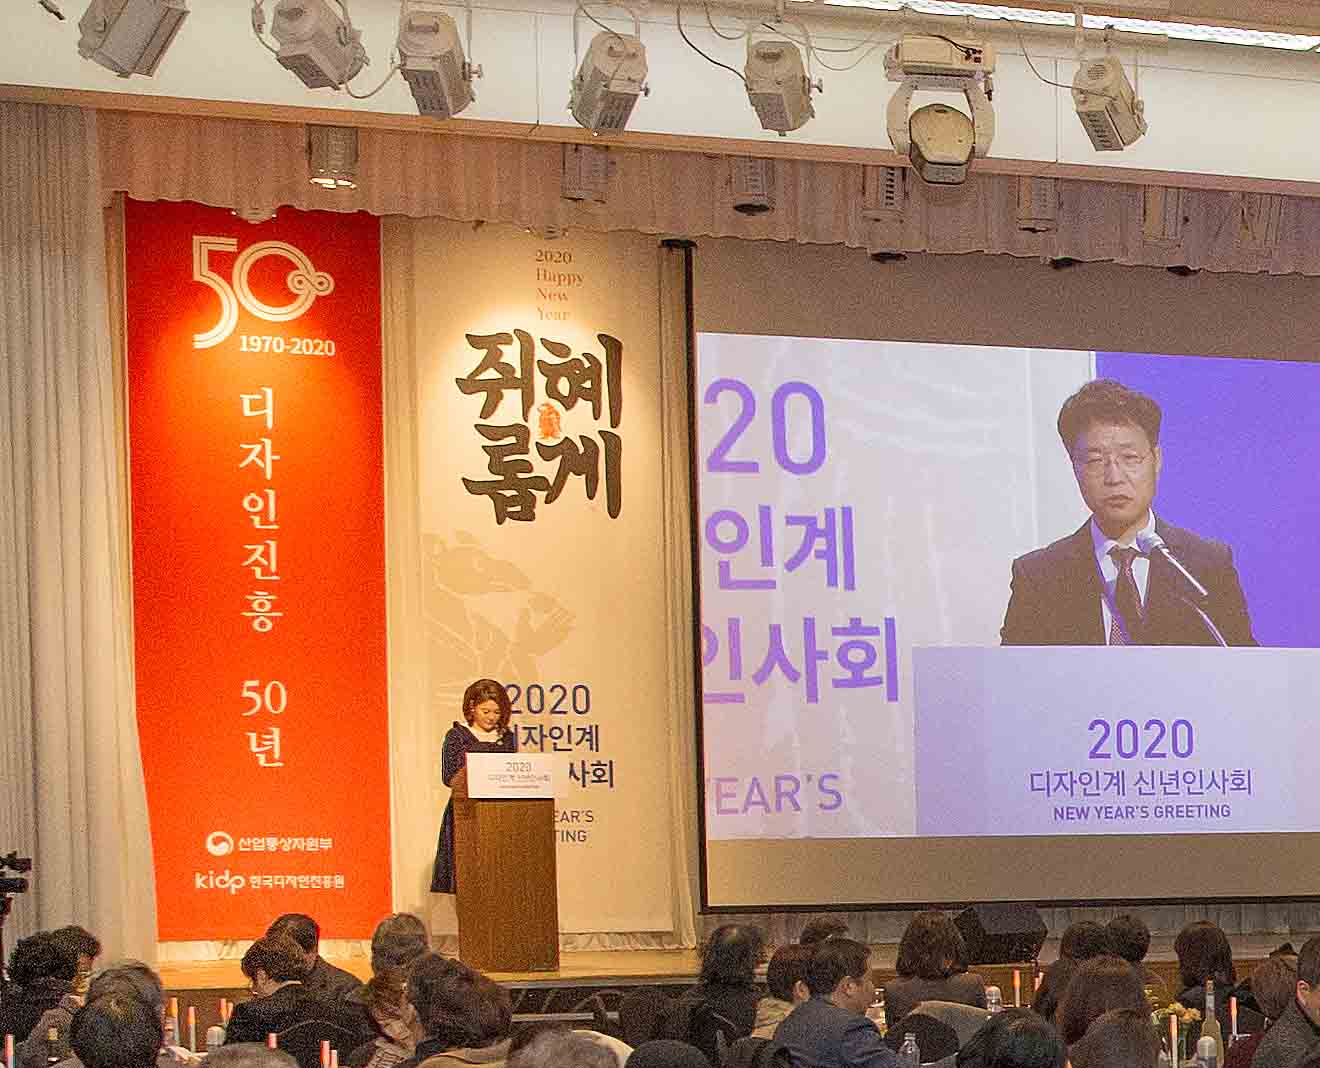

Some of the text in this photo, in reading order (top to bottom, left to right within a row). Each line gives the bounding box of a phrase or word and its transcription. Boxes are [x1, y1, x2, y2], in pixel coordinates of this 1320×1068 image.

[536, 250, 572, 263] 2020
[537, 268, 584, 286] Happy
[538, 288, 568, 301] New
[538, 307, 570, 320] Year
[240, 335, 336, 356] 1970-2020
[703, 378, 828, 475] 20
[703, 506, 856, 592] 인계
[240, 386, 287, 768] 디자인진흥 50년
[504, 684, 590, 714] 2020
[1088, 718, 1194, 761] 2020
[568, 760, 614, 788] 사회
[1029, 767, 1252, 798] 디자인계 신년인사회
[552, 810, 594, 823] EAR'S
[1053, 803, 1231, 820] NEW YEAR'S GREETING
[239, 837, 333, 852] 산업통상자원부
[195, 869, 245, 894] kidp
